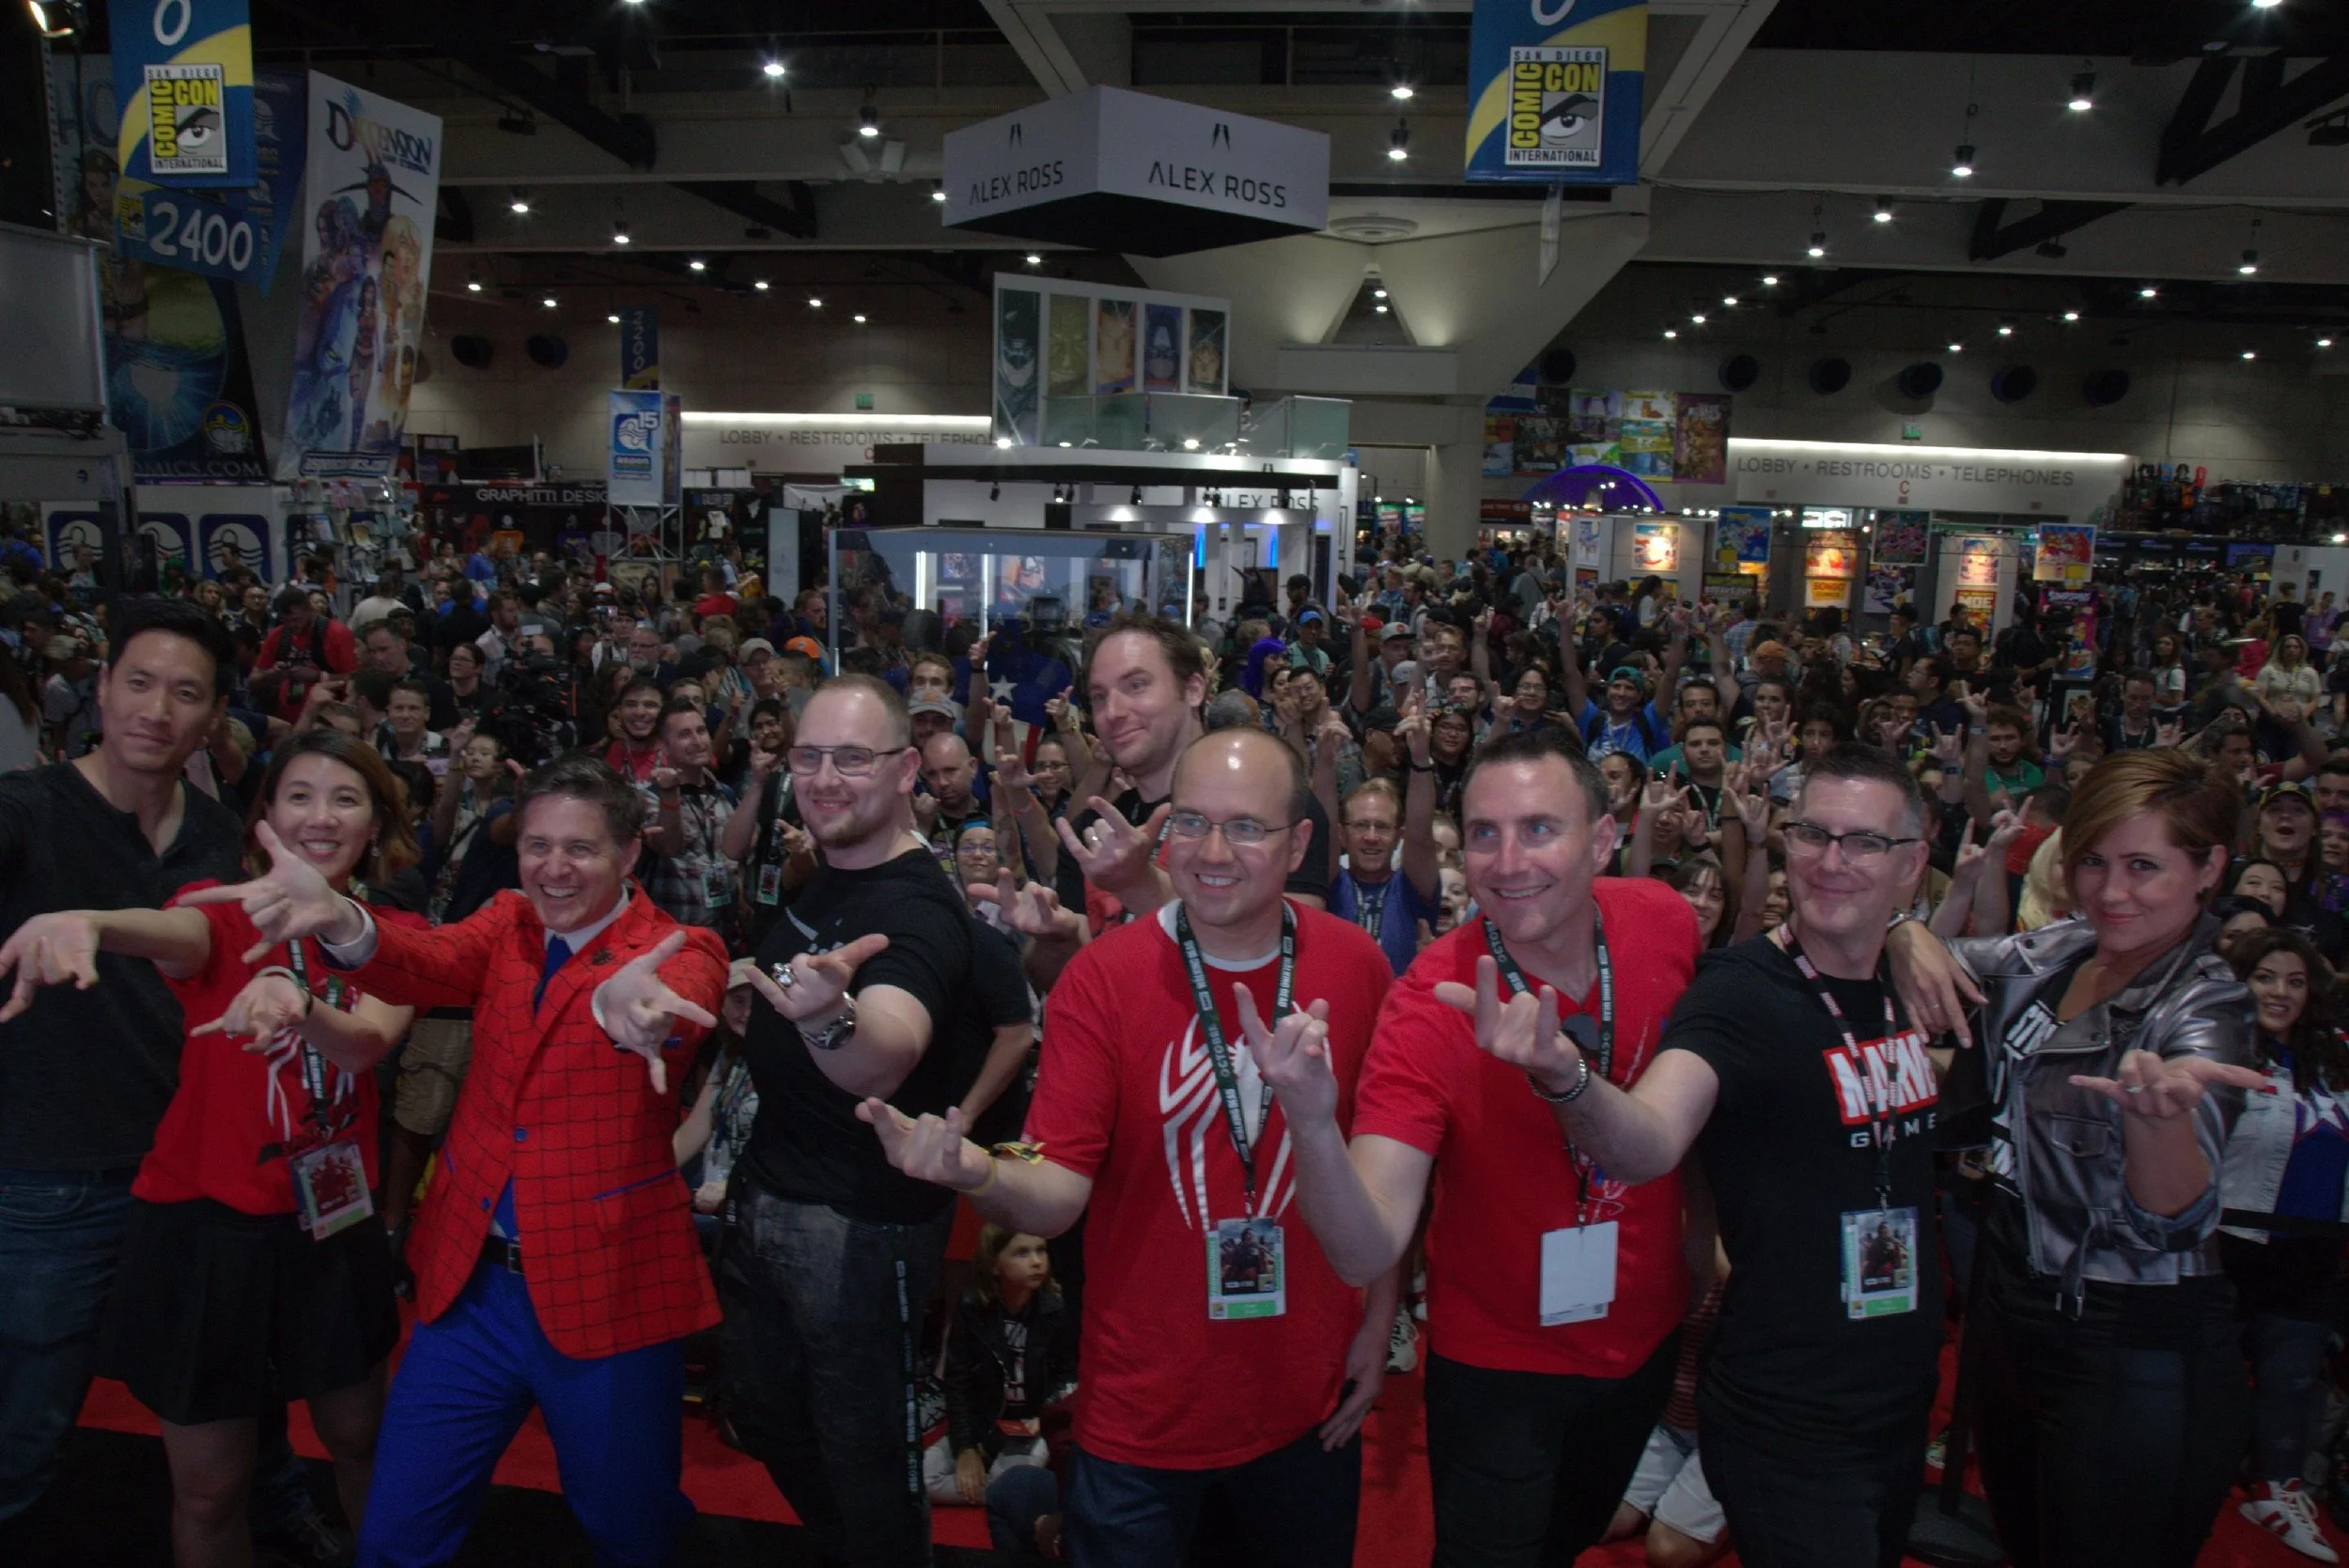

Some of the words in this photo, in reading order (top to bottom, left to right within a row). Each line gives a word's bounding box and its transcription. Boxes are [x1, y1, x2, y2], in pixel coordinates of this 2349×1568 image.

[1515, 51, 1542, 60] SAN
[1556, 51, 1602, 61] DIEGO
[148, 69, 170, 78] SAN
[181, 69, 219, 78] DIEGO
[1544, 63, 1601, 92] CON
[174, 79, 218, 105] CON
[151, 79, 178, 157] COMIC
[1511, 63, 1543, 148] COMIC
[154, 157, 224, 169] INTERNATIONAL
[1509, 150, 1596, 163] INTERNATIONAL
[970, 175, 1012, 207] ALEX
[1017, 161, 1064, 191] ROSS
[1148, 161, 1216, 195] ALEX
[1224, 176, 1287, 208] ROSS
[149, 201, 253, 272] 2400
[636, 411, 658, 429] 15
[721, 430, 771, 444] LOBBY
[789, 430, 892, 445] RESTROOMS
[1738, 458, 1797, 473] LOBBY
[1817, 460, 1932, 480] RESTROOMS
[1953, 465, 2074, 487] TELEPHONES
[475, 489, 557, 503] GRAPHITTI
[564, 489, 608, 504] DESIG
[1900, 481, 1909, 495] C
[1828, 1033, 1938, 1118] MARVE
